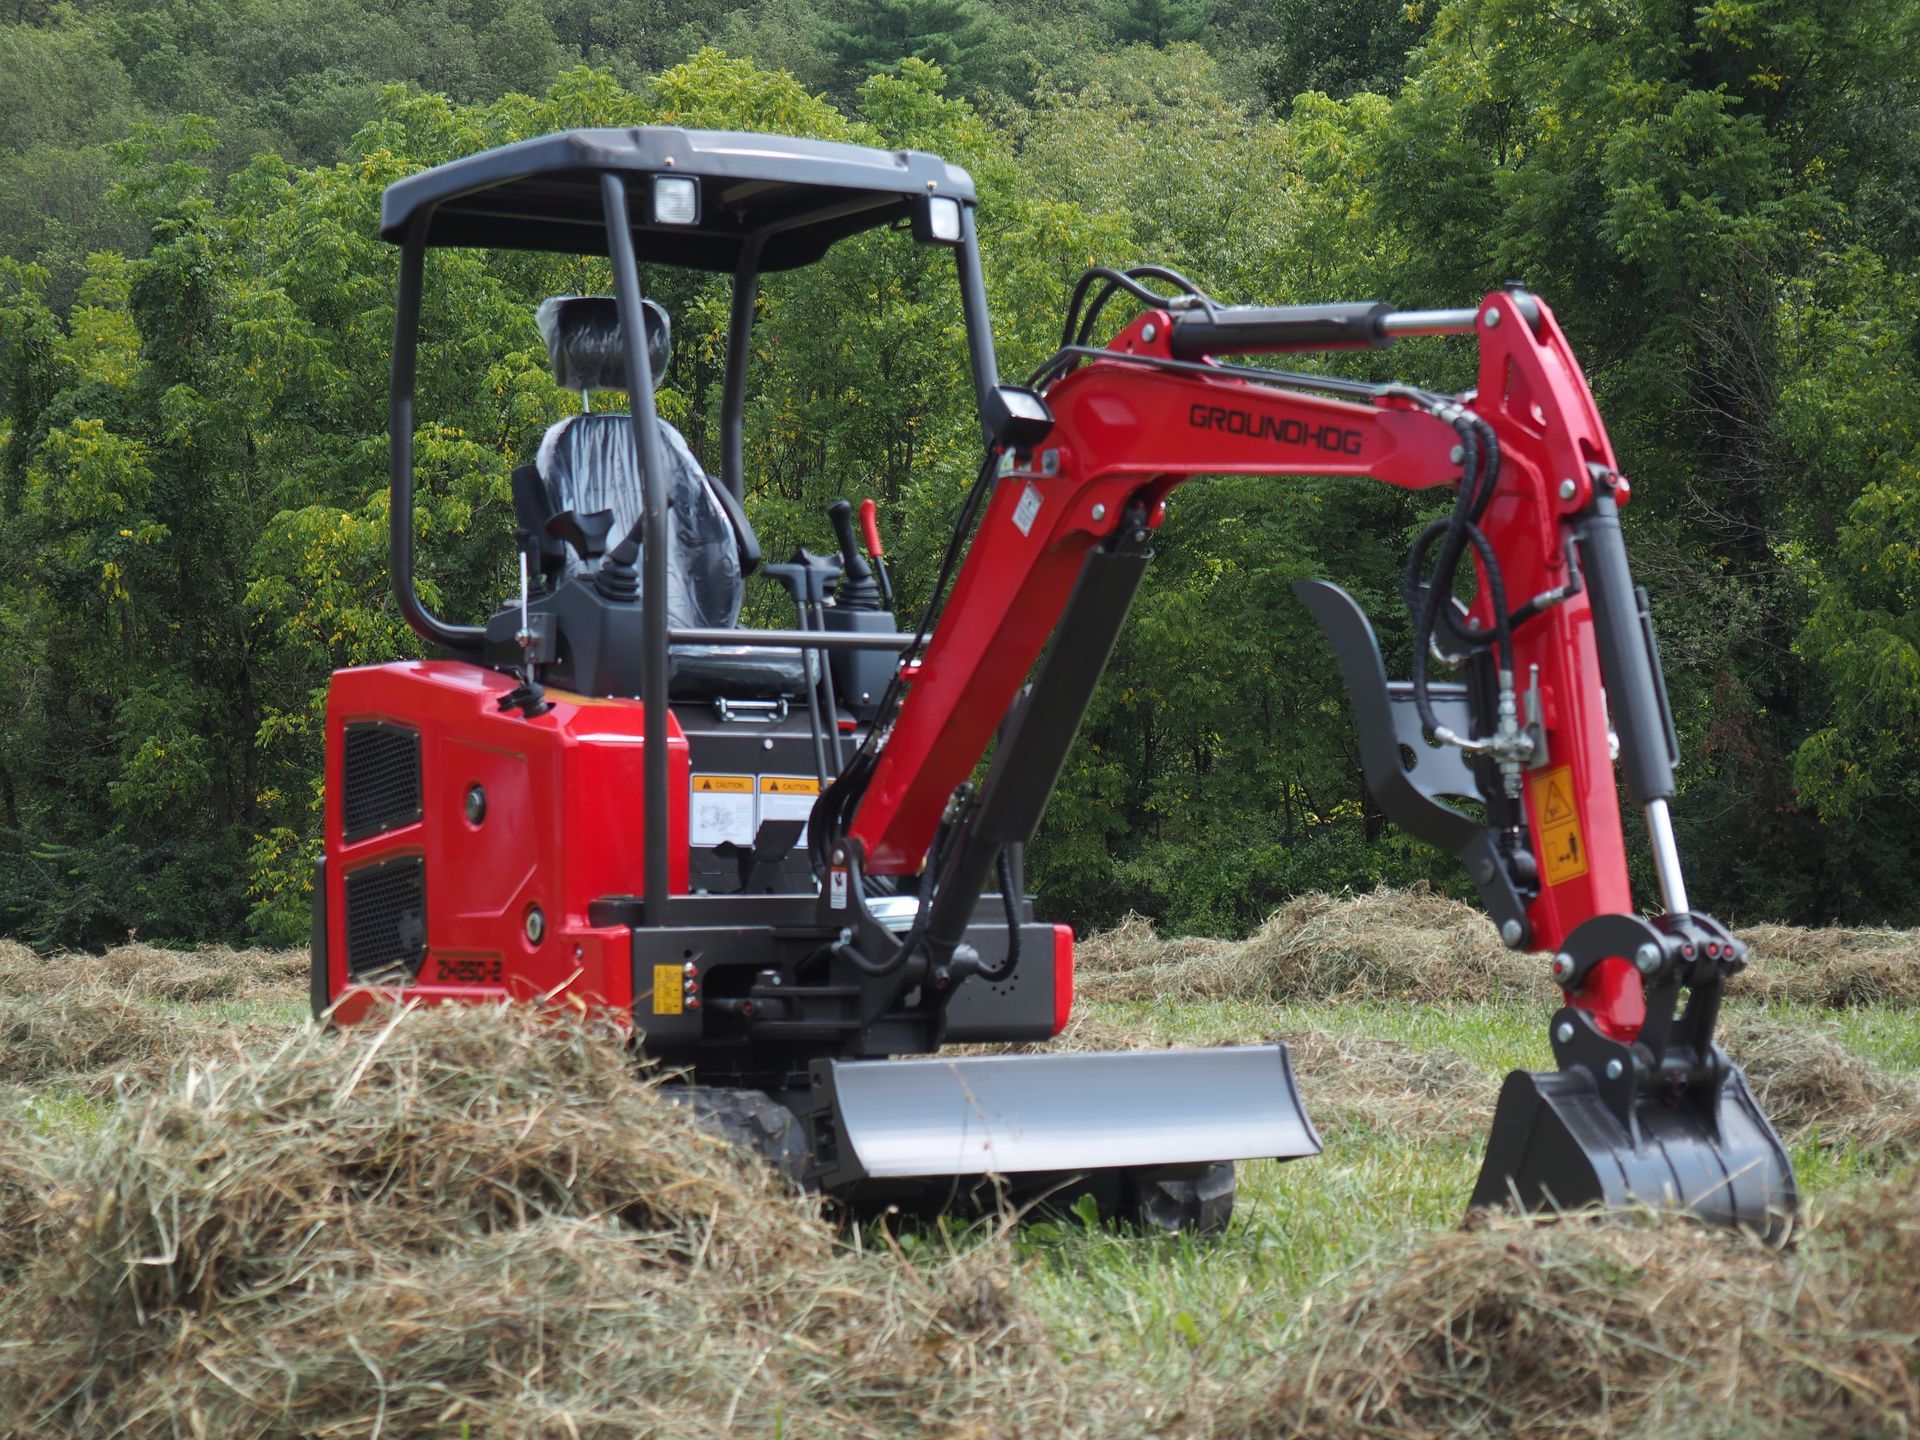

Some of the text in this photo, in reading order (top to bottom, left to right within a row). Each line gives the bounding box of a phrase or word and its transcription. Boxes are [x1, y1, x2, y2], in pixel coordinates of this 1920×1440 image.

[1189, 403, 1363, 455] GROUNDHOG
[715, 781, 745, 790] CAUTION
[782, 783, 811, 792] CAUTION
